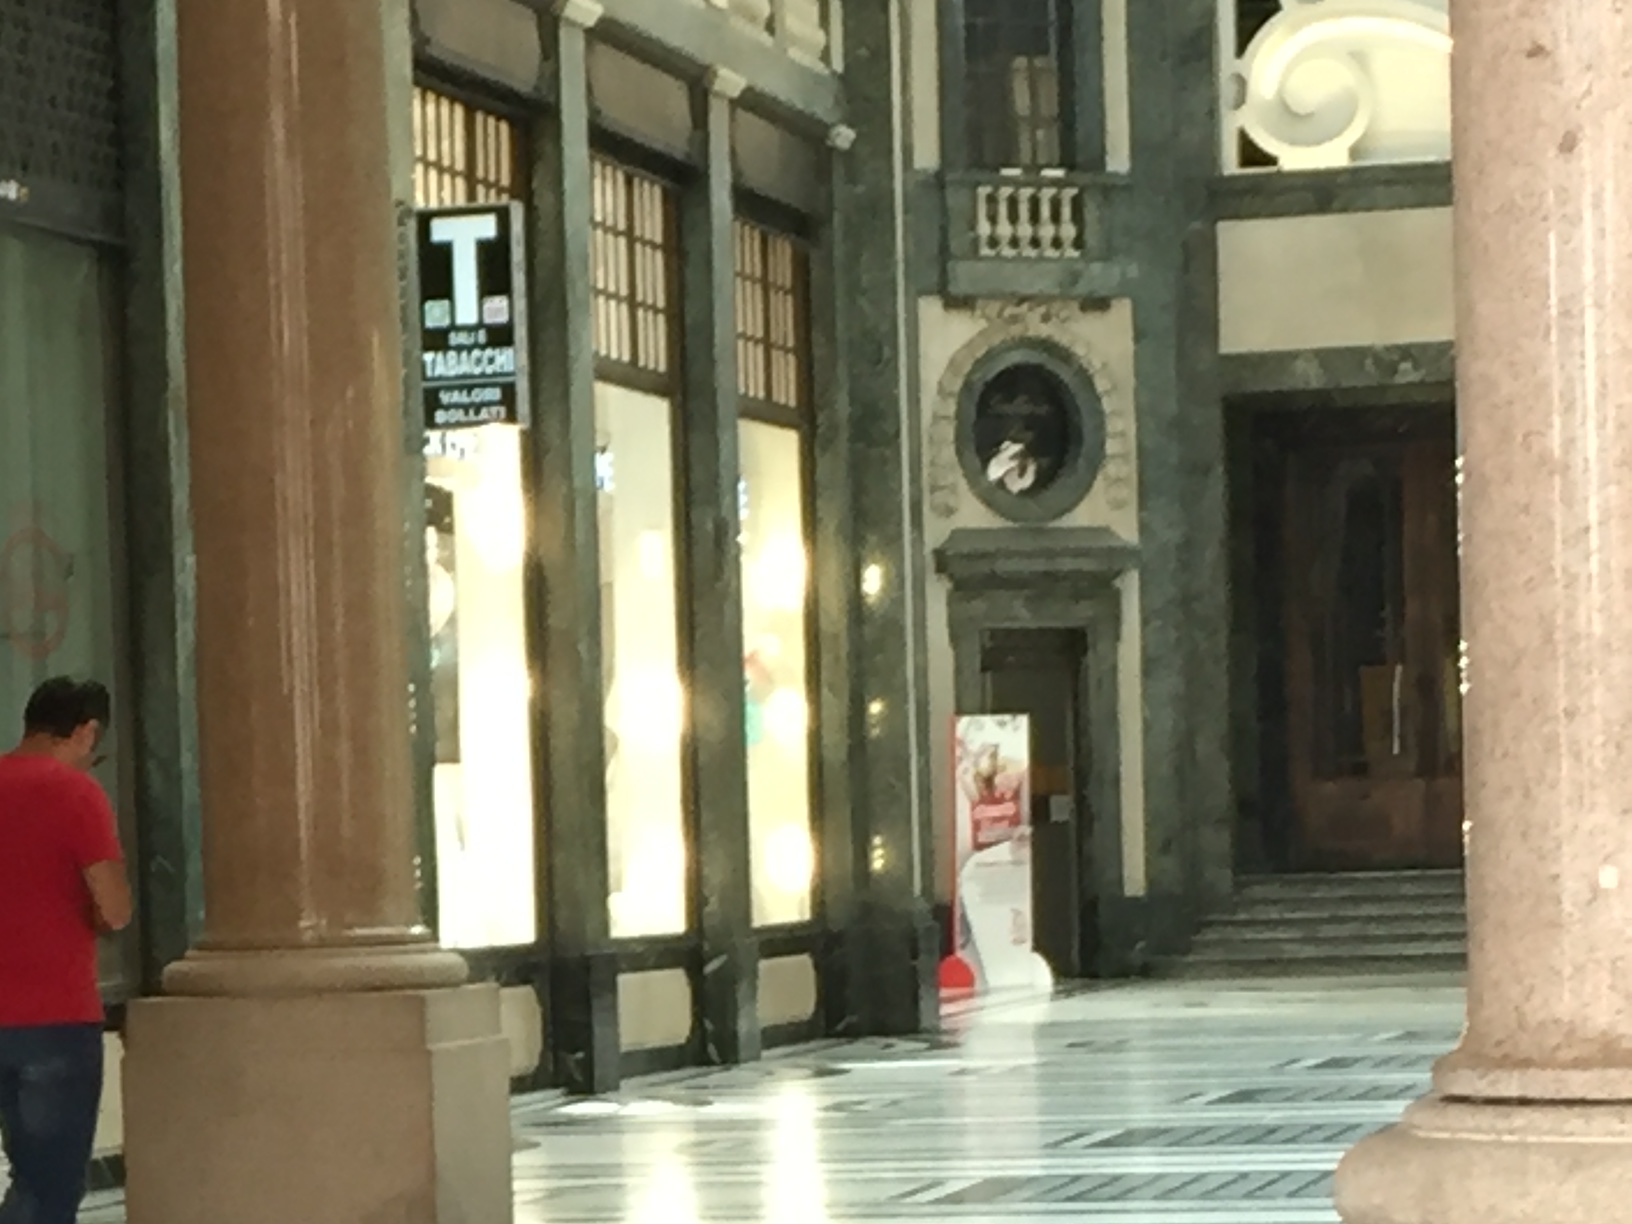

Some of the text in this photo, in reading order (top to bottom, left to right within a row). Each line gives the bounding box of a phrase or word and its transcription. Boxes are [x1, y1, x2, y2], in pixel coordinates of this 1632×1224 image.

[429, 213, 498, 326] T
[422, 346, 515, 378] TABACCHI
[438, 387, 502, 405] VALORI
[433, 405, 508, 424] BOLLATI
